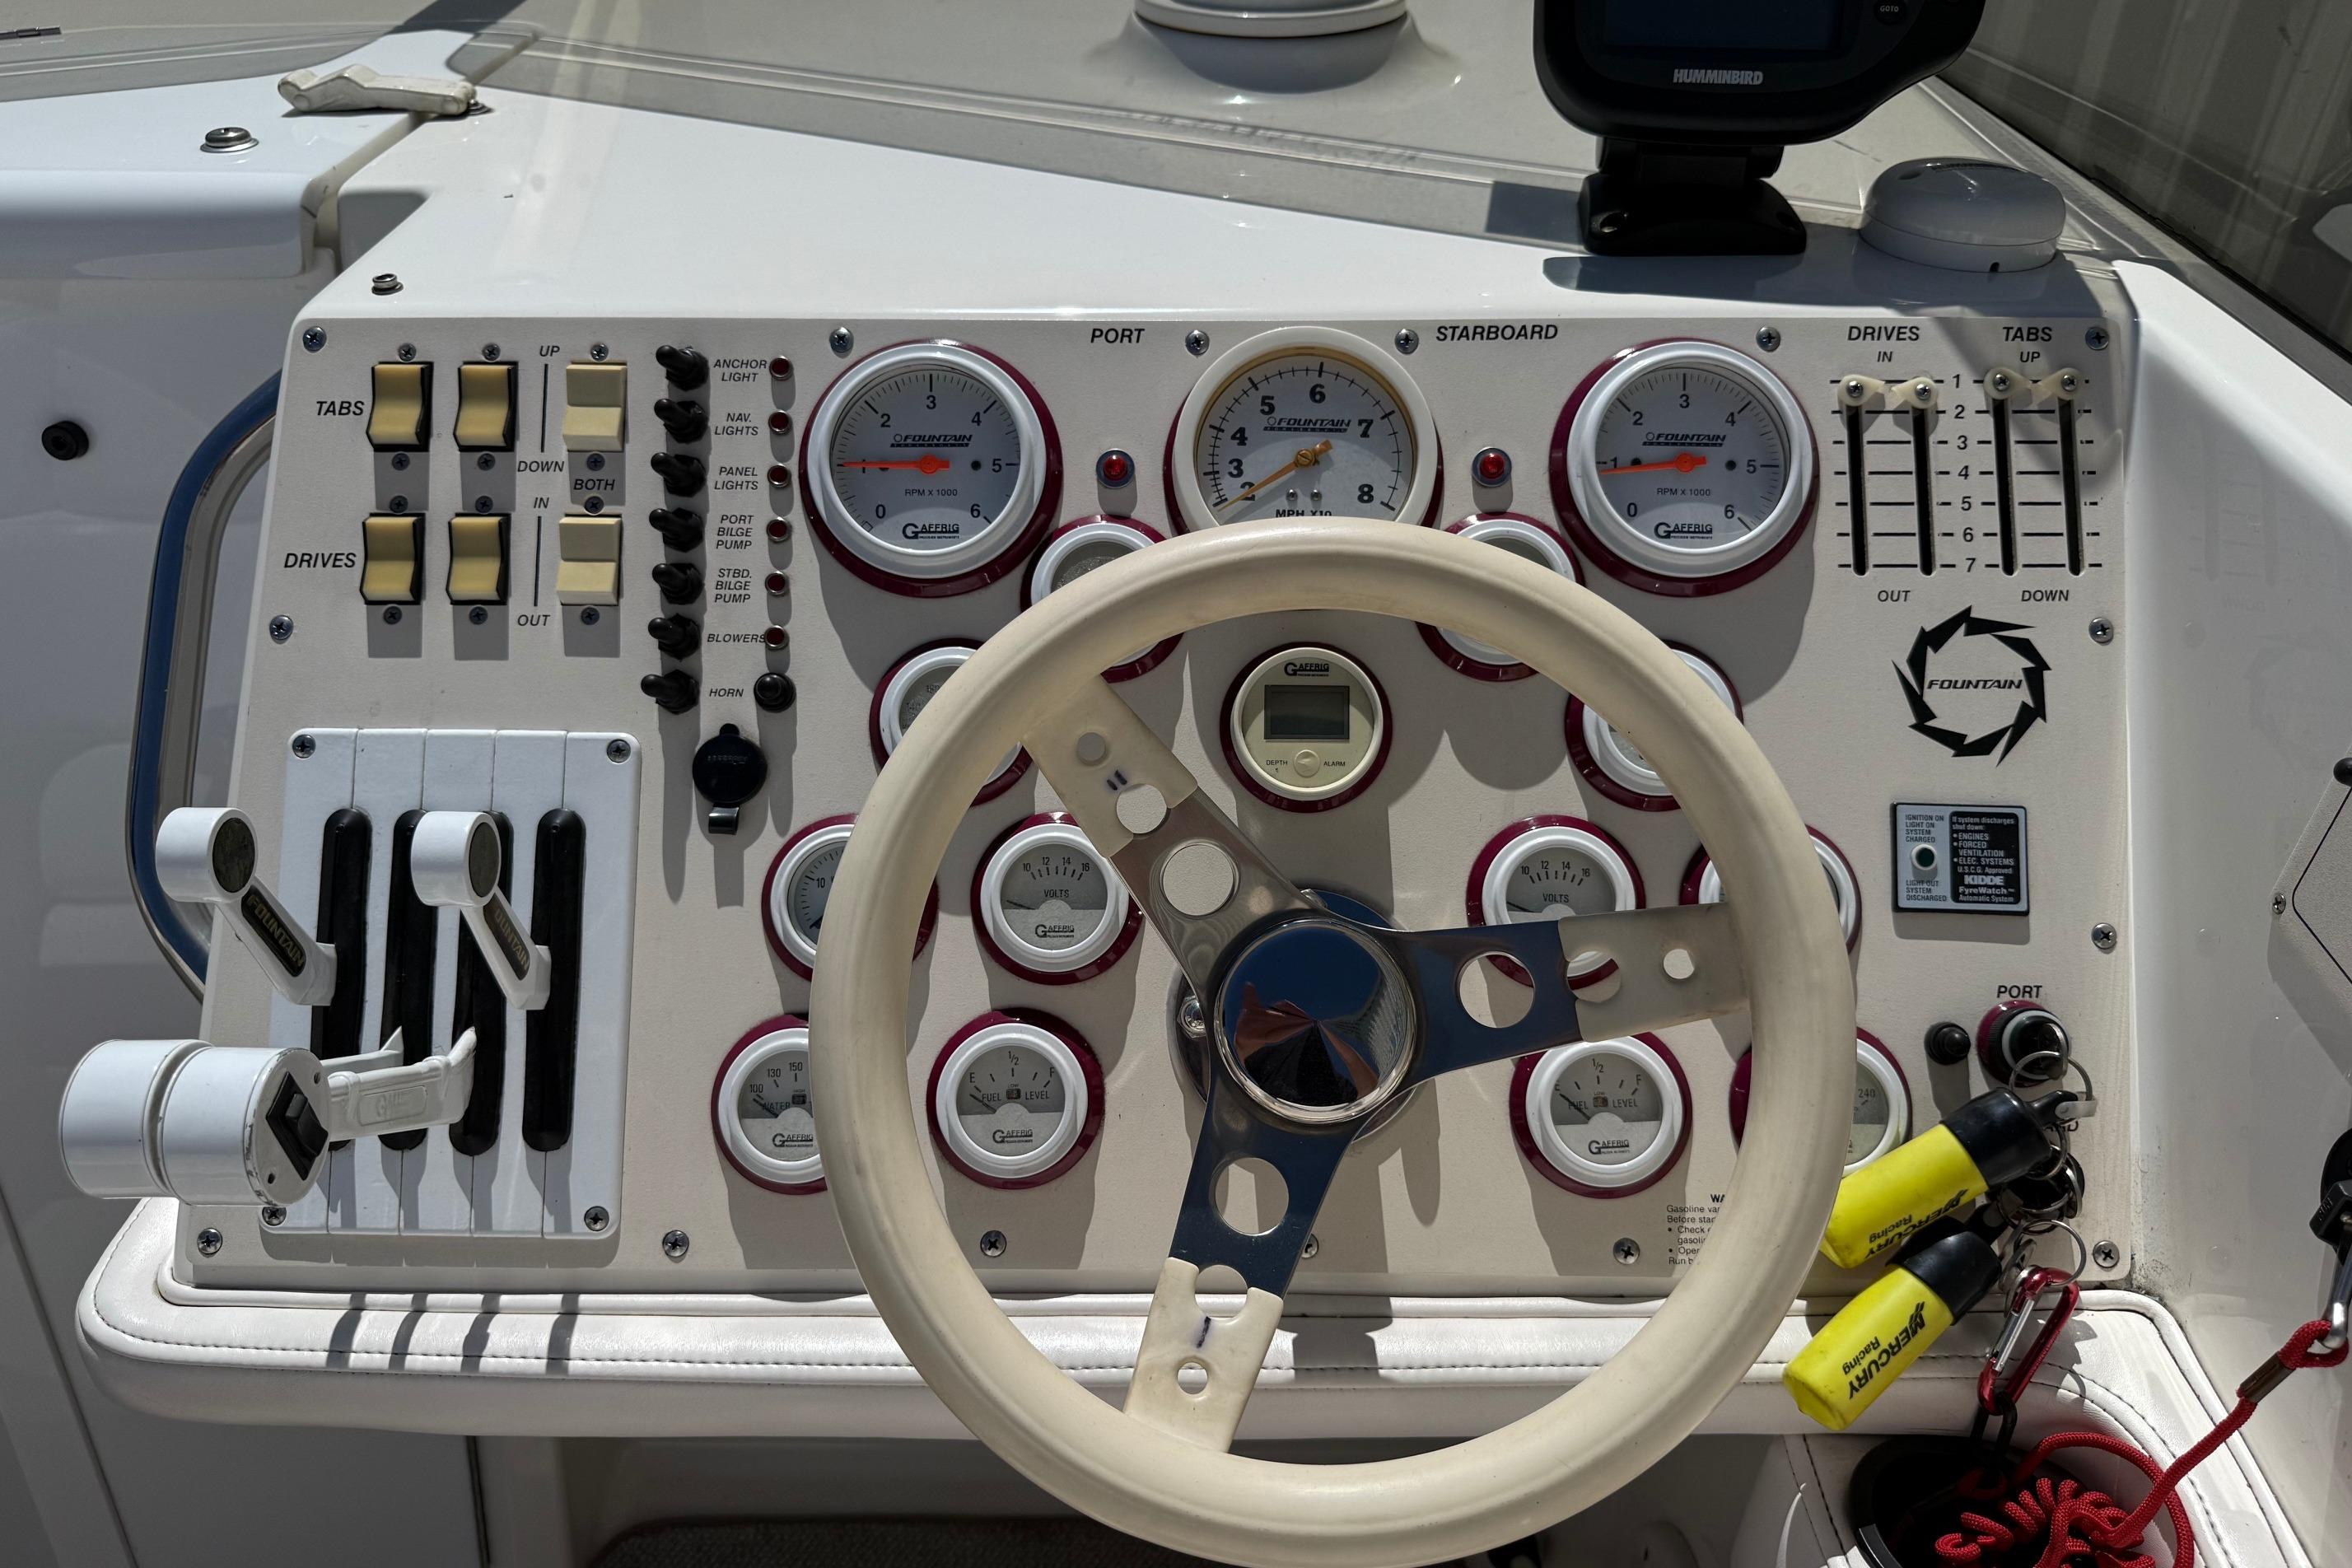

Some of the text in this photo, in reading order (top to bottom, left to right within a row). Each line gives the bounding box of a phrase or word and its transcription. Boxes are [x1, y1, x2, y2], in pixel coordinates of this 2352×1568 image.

[1673, 68, 1763, 85] HUMMINBIRD
[1090, 328, 1145, 344] PORT
[1436, 324, 1559, 342] STARBOARD
[1847, 326, 1920, 342] DRIVES
[2002, 326, 2053, 342] TABS
[539, 346, 560, 357] UP
[1877, 351, 1893, 362] IN
[2019, 351, 2041, 363] UP
[713, 359, 768, 369] ANCHOR
[721, 372, 758, 382] LIGHT
[1952, 374, 1962, 389] 1
[1309, 384, 1326, 404] 6
[926, 395, 936, 409] 3
[1259, 395, 1276, 415] 5
[1679, 394, 1690, 408] 3
[315, 400, 365, 417] TABS
[1953, 404, 1965, 419] 2
[726, 413, 751, 422] NAV.
[880, 413, 891, 428] 2
[971, 412, 982, 426] 4
[1277, 418, 1351, 427] FOUNTAIN
[1633, 412, 1643, 426] 2
[1725, 412, 1736, 427] 4
[714, 426, 758, 436] LIGHTS
[1357, 419, 1374, 438] 7
[903, 434, 973, 442] FOUNTAIN
[1230, 427, 1248, 446] 4
[1656, 433, 1726, 442] FOUNTAIN
[1957, 435, 1968, 450] 3
[517, 460, 565, 474] DOWN
[992, 459, 1002, 473] 5
[1228, 458, 1244, 478] 3
[1611, 457, 1618, 469] 1
[1746, 460, 1757, 474] 5
[719, 466, 758, 476] PANEL
[1958, 465, 1970, 480] 4
[573, 478, 615, 492] BOTH
[714, 480, 758, 490] LIGHTS
[905, 488, 926, 497] RPM
[936, 488, 958, 497] 1000
[1239, 482, 1256, 501] 2
[1357, 483, 1374, 504] 8
[1657, 488, 1678, 496] RPM
[1689, 488, 1710, 497] 1000
[533, 497, 549, 509] IN
[1961, 497, 1972, 511] 5
[875, 505, 886, 519] 0
[971, 504, 981, 518] 6
[1276, 509, 1304, 517] MPH
[1626, 502, 1638, 517] 0
[1724, 504, 1735, 519] 6
[721, 515, 754, 525] PORT
[717, 527, 753, 537] BILGE
[902, 523, 959, 539] GAFFRIG
[1654, 522, 1713, 539] GAFFRIG
[1962, 527, 1974, 543] 6
[716, 540, 752, 549] PUMP
[283, 553, 357, 569] DRIVES
[1965, 558, 1976, 573] 7
[718, 568, 752, 578] STBD.
[716, 581, 751, 590] BILGE
[715, 594, 751, 603] PUMP
[1877, 590, 1911, 602] OUT
[2021, 590, 2070, 602] DOWN
[517, 614, 550, 627] OUT
[707, 633, 766, 643] BLOWERS
[1284, 662, 1329, 676] GAFFRIG
[1926, 679, 2022, 689] FOUNTAIN
[709, 688, 744, 698] HORN
[1958, 849, 2004, 857] VENTILATION
[1023, 862, 1031, 871] 10
[1042, 856, 1050, 866] 12
[1062, 857, 1071, 866] 14
[1081, 862, 1090, 871] 16
[1541, 861, 1549, 870] 12
[1561, 861, 1570, 870] 14
[1981, 857, 2014, 866] SYSTEMS
[1521, 866, 1529, 875] 10
[1581, 868, 1590, 877] 16
[1985, 866, 2013, 875] Approved
[816, 877, 825, 888] 10
[1964, 875, 2004, 885] KIDDE
[1043, 889, 1069, 898] VOLTS
[1542, 893, 1569, 903] VOLTS
[247, 895, 305, 967] FOUNTAIN
[1035, 924, 1074, 938] GAFFRIG
[494, 908, 530, 970] OUNTAIN
[1996, 985, 2042, 999] PORT
[789, 1062, 803, 1071] 150
[1049, 1067, 1055, 1078] F
[768, 1068, 782, 1078] 130
[969, 1072, 975, 1083] E
[1636, 1074, 1641, 1085] F
[749, 1084, 763, 1094] 100
[1858, 1088, 1876, 1098] 240
[982, 1090, 1049, 1102] FUEL LEVEL
[763, 1102, 791, 1110] WATER
[1568, 1098, 1638, 1110] FUEL LEVEL
[772, 1133, 813, 1147] GAFFRIG
[992, 1129, 1033, 1144] GAFFRIG
[1589, 1140, 1630, 1155] GAFFRIG
[1666, 1205, 1705, 1213] Gasoline
[1667, 1215, 1696, 1223] Before
[1678, 1225, 1705, 1234] Check
[1869, 1214, 1912, 1244] Racing
[1668, 1257, 1686, 1265] Run
[1842, 1336, 1881, 1375] Racing
[1849, 1301, 1925, 1400] MERCURY
